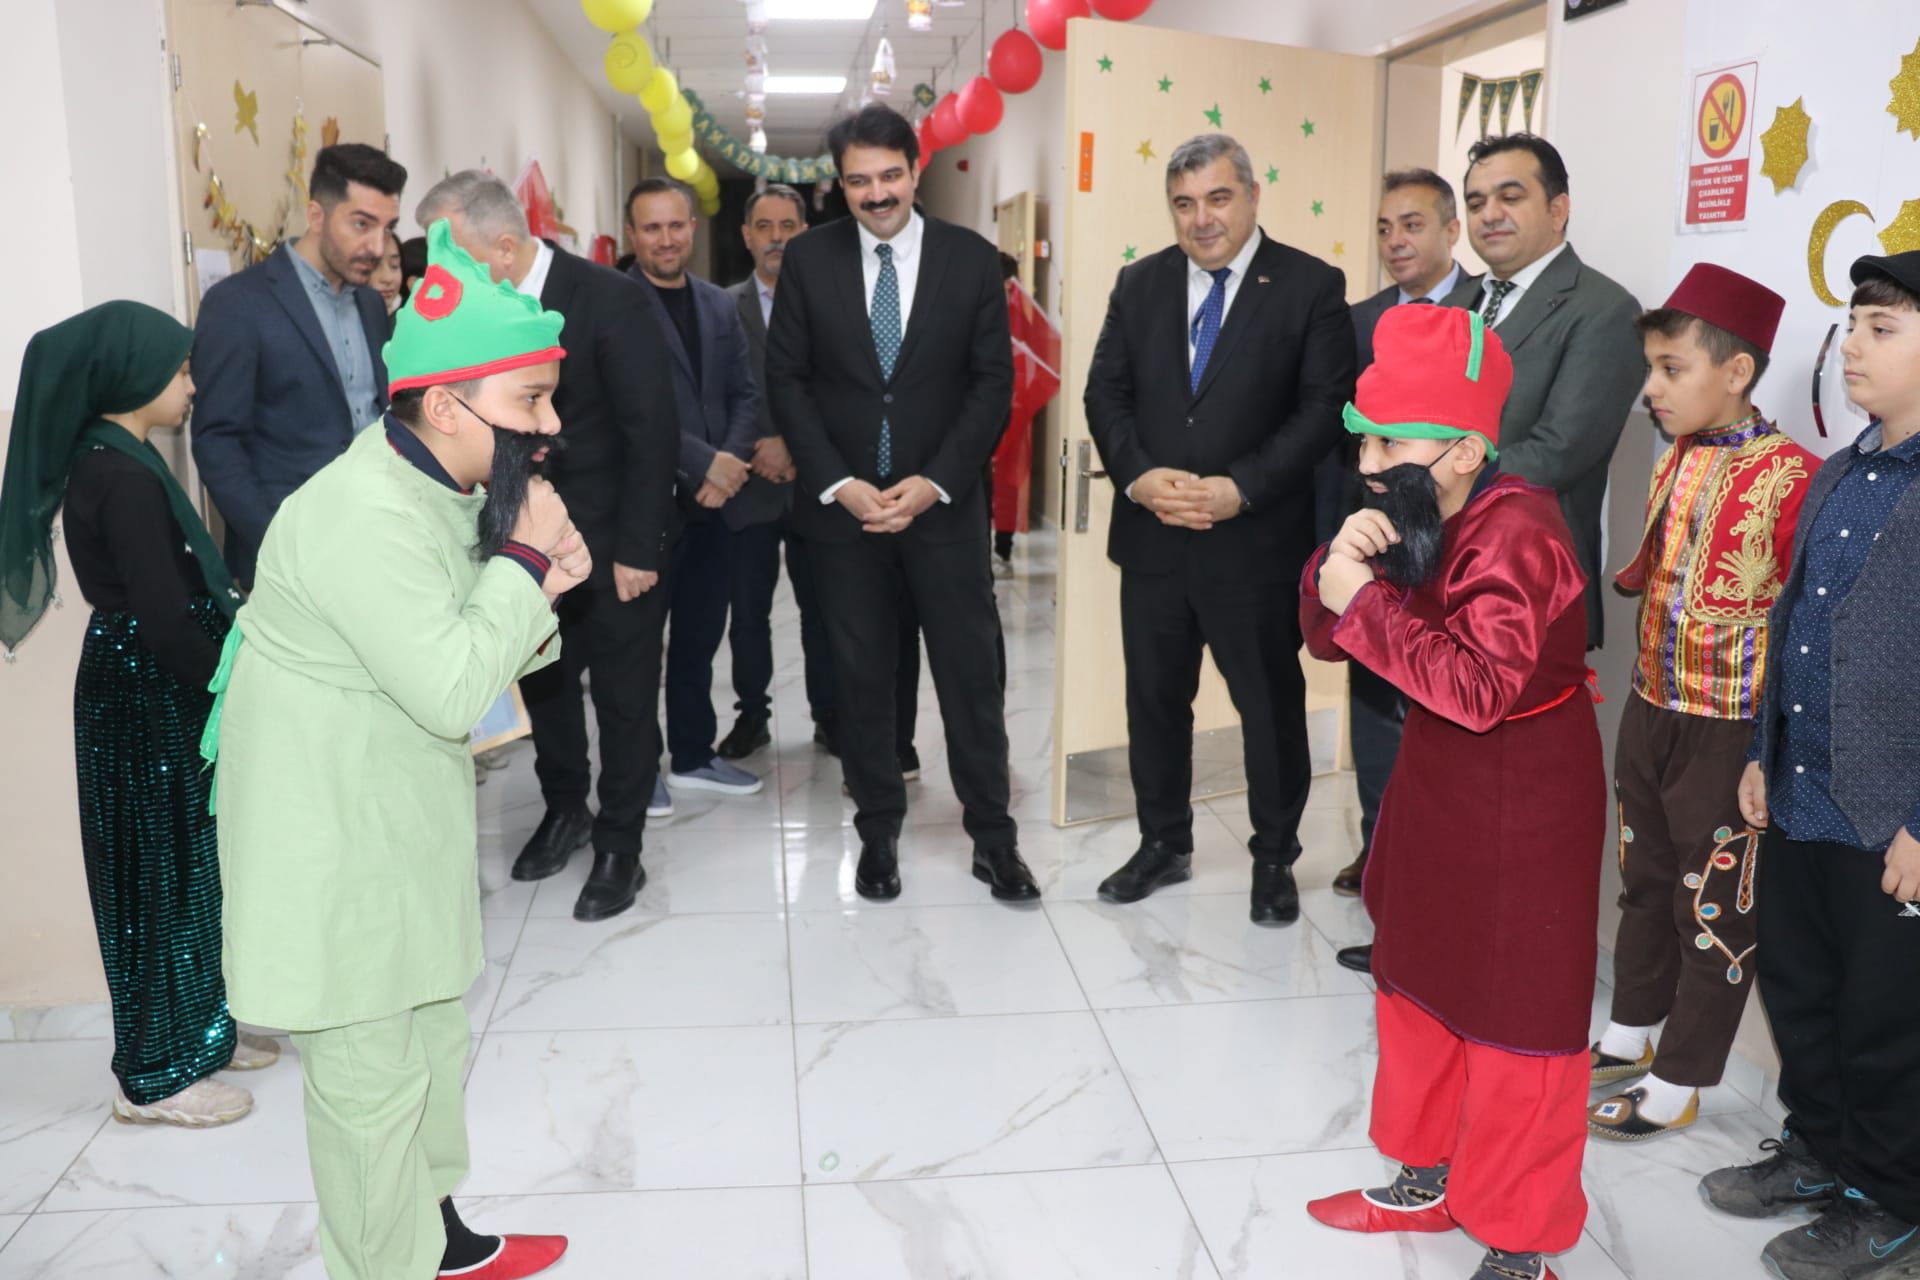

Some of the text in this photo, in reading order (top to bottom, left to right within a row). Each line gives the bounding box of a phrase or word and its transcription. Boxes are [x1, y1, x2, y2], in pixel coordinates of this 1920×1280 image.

[1703, 164, 1732, 174] SINIFLARA
[1713, 176, 1720, 184] VE
[1698, 211, 1727, 219] YASAKTIR
